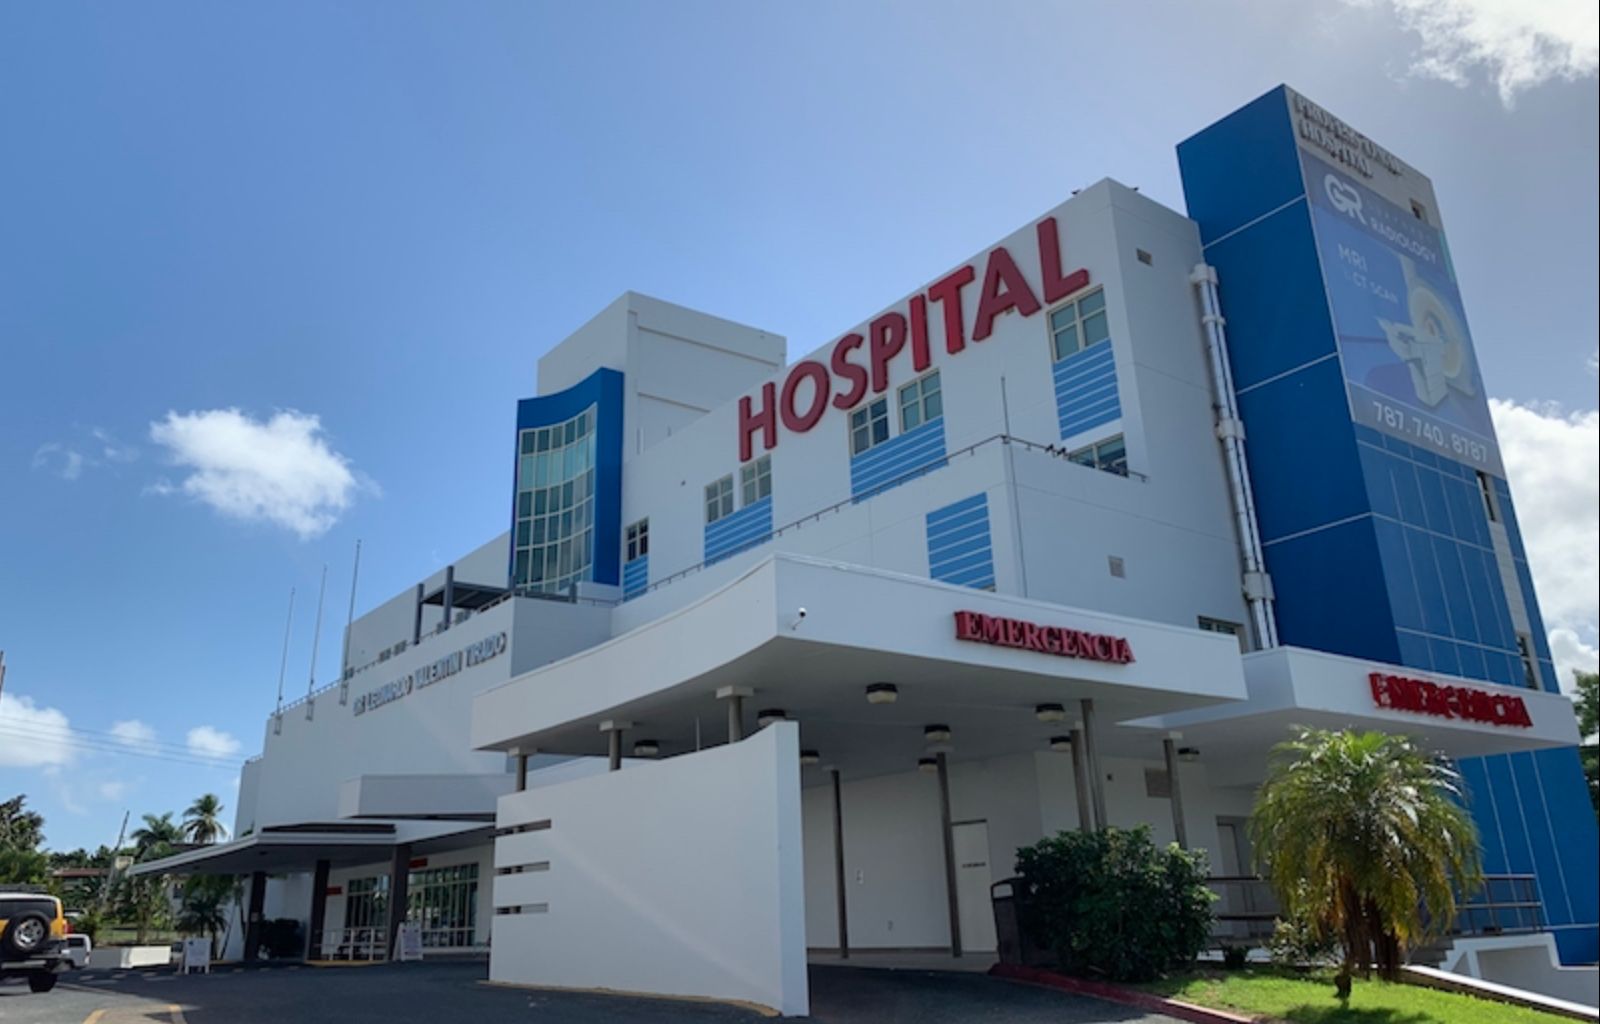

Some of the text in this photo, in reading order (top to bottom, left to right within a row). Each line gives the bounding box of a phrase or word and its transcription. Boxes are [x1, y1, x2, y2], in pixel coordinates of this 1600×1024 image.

[1324, 173, 1368, 225] GR
[1338, 242, 1368, 272] MRI
[1370, 216, 1437, 265] RADIOLOGY
[738, 216, 1091, 463] HOSPITAL
[954, 610, 1136, 665] EMERGENCIA
